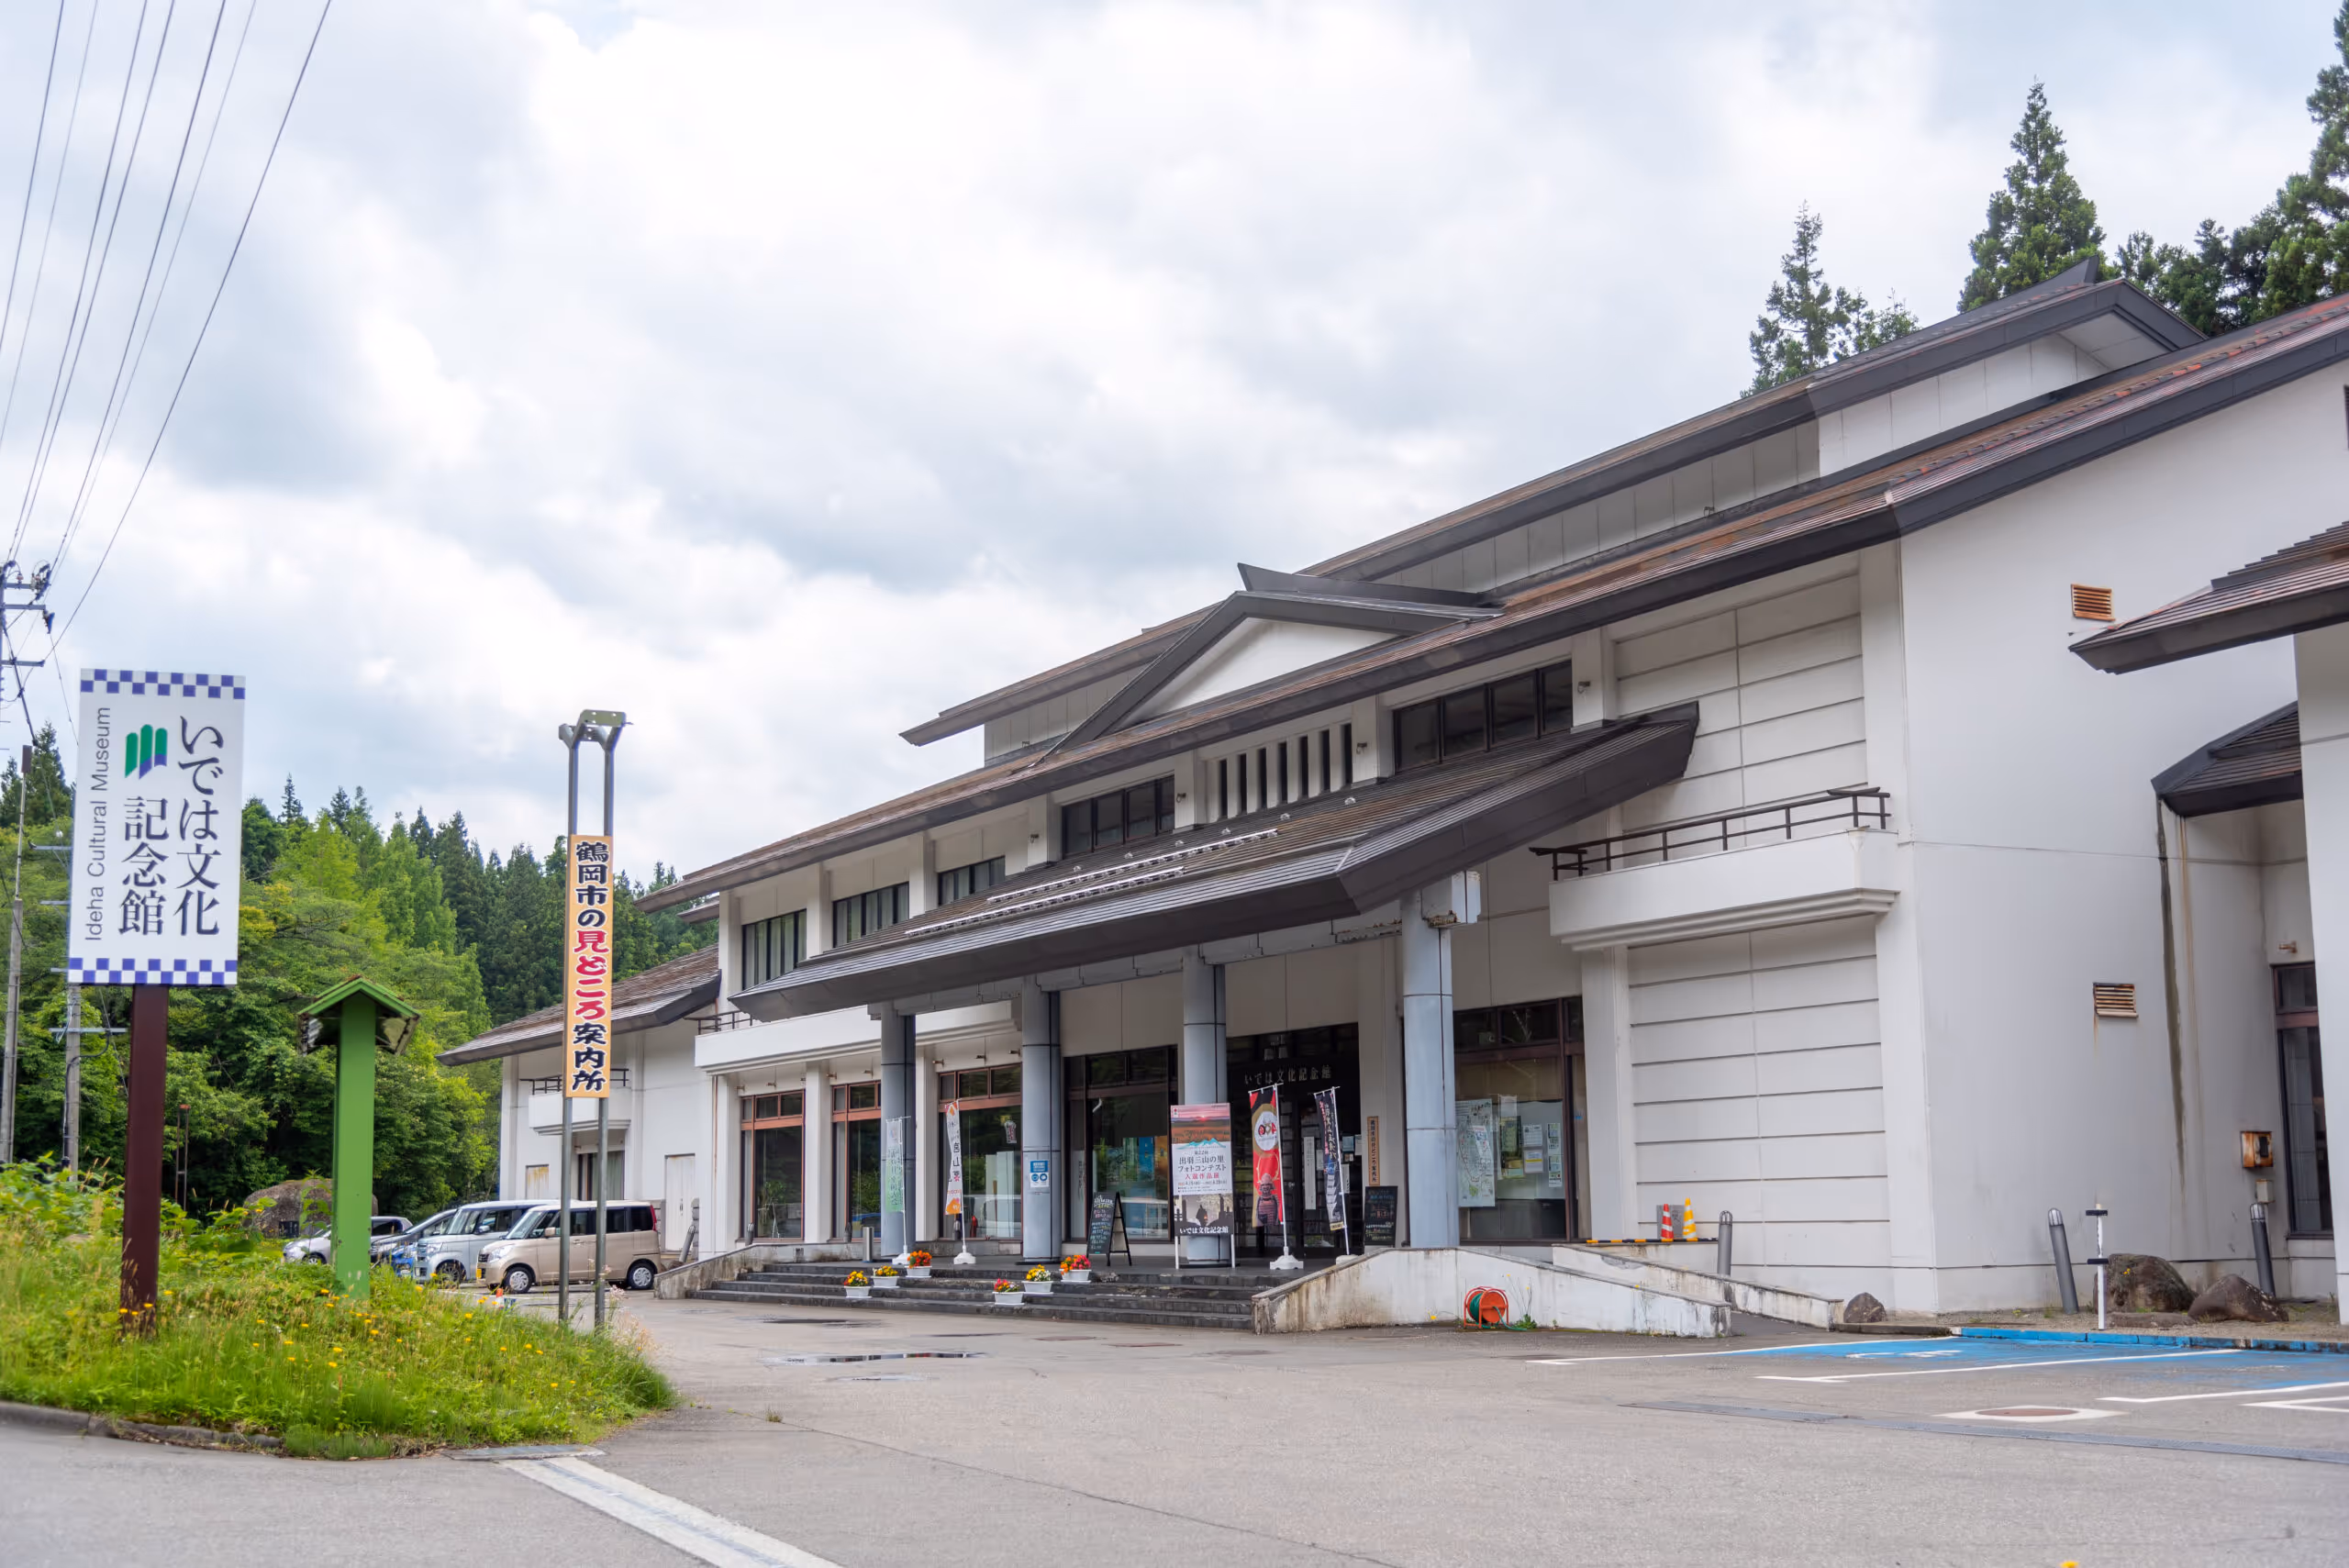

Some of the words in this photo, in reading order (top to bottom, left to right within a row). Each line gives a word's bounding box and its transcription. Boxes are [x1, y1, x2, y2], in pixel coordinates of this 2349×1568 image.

[90, 706, 111, 792] Museum
[86, 800, 107, 878] Cultural
[173, 715, 224, 936] いでは文化
[118, 795, 170, 936] 記念館
[84, 885, 105, 941] Ideha
[573, 842, 609, 1092] 鶴岡市の見どころ案内所
[1244, 1065, 1331, 1084] いでは文化記念館
[1178, 1163, 1227, 1173] フォトコンテスト
[1179, 1225, 1229, 1234] いでは文化記念館
